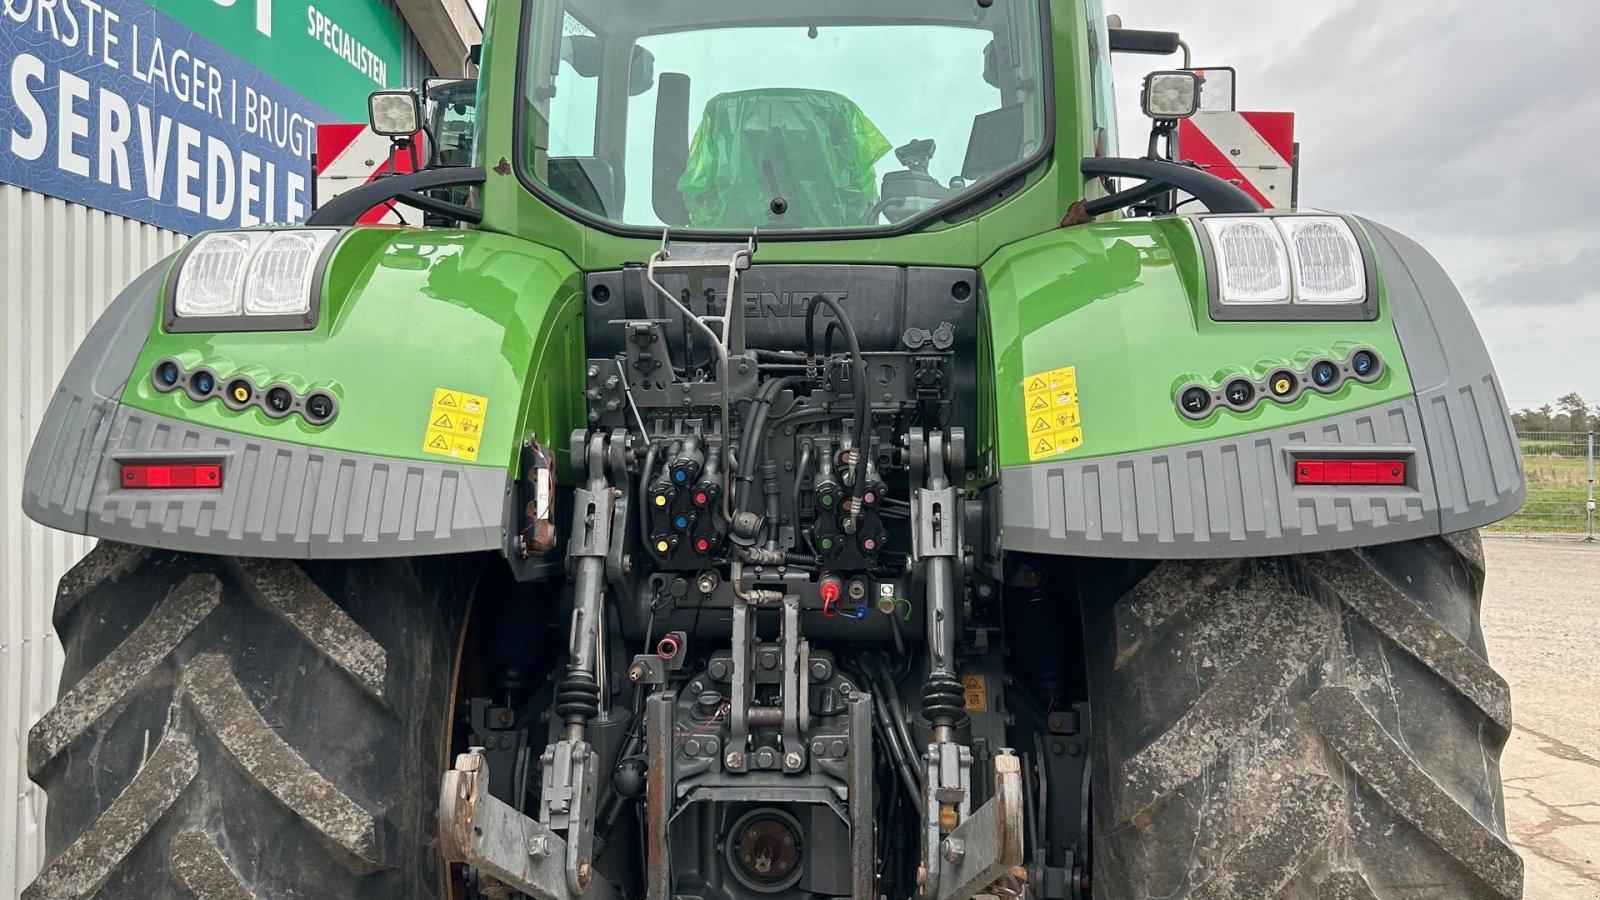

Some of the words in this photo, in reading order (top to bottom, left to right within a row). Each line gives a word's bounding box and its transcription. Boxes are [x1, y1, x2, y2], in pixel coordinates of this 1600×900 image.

[132, 23, 223, 119] LAGER
[231, 78, 237, 125] I
[245, 86, 315, 161] BRUGT
[307, 5, 387, 88] SPECIALISTEN
